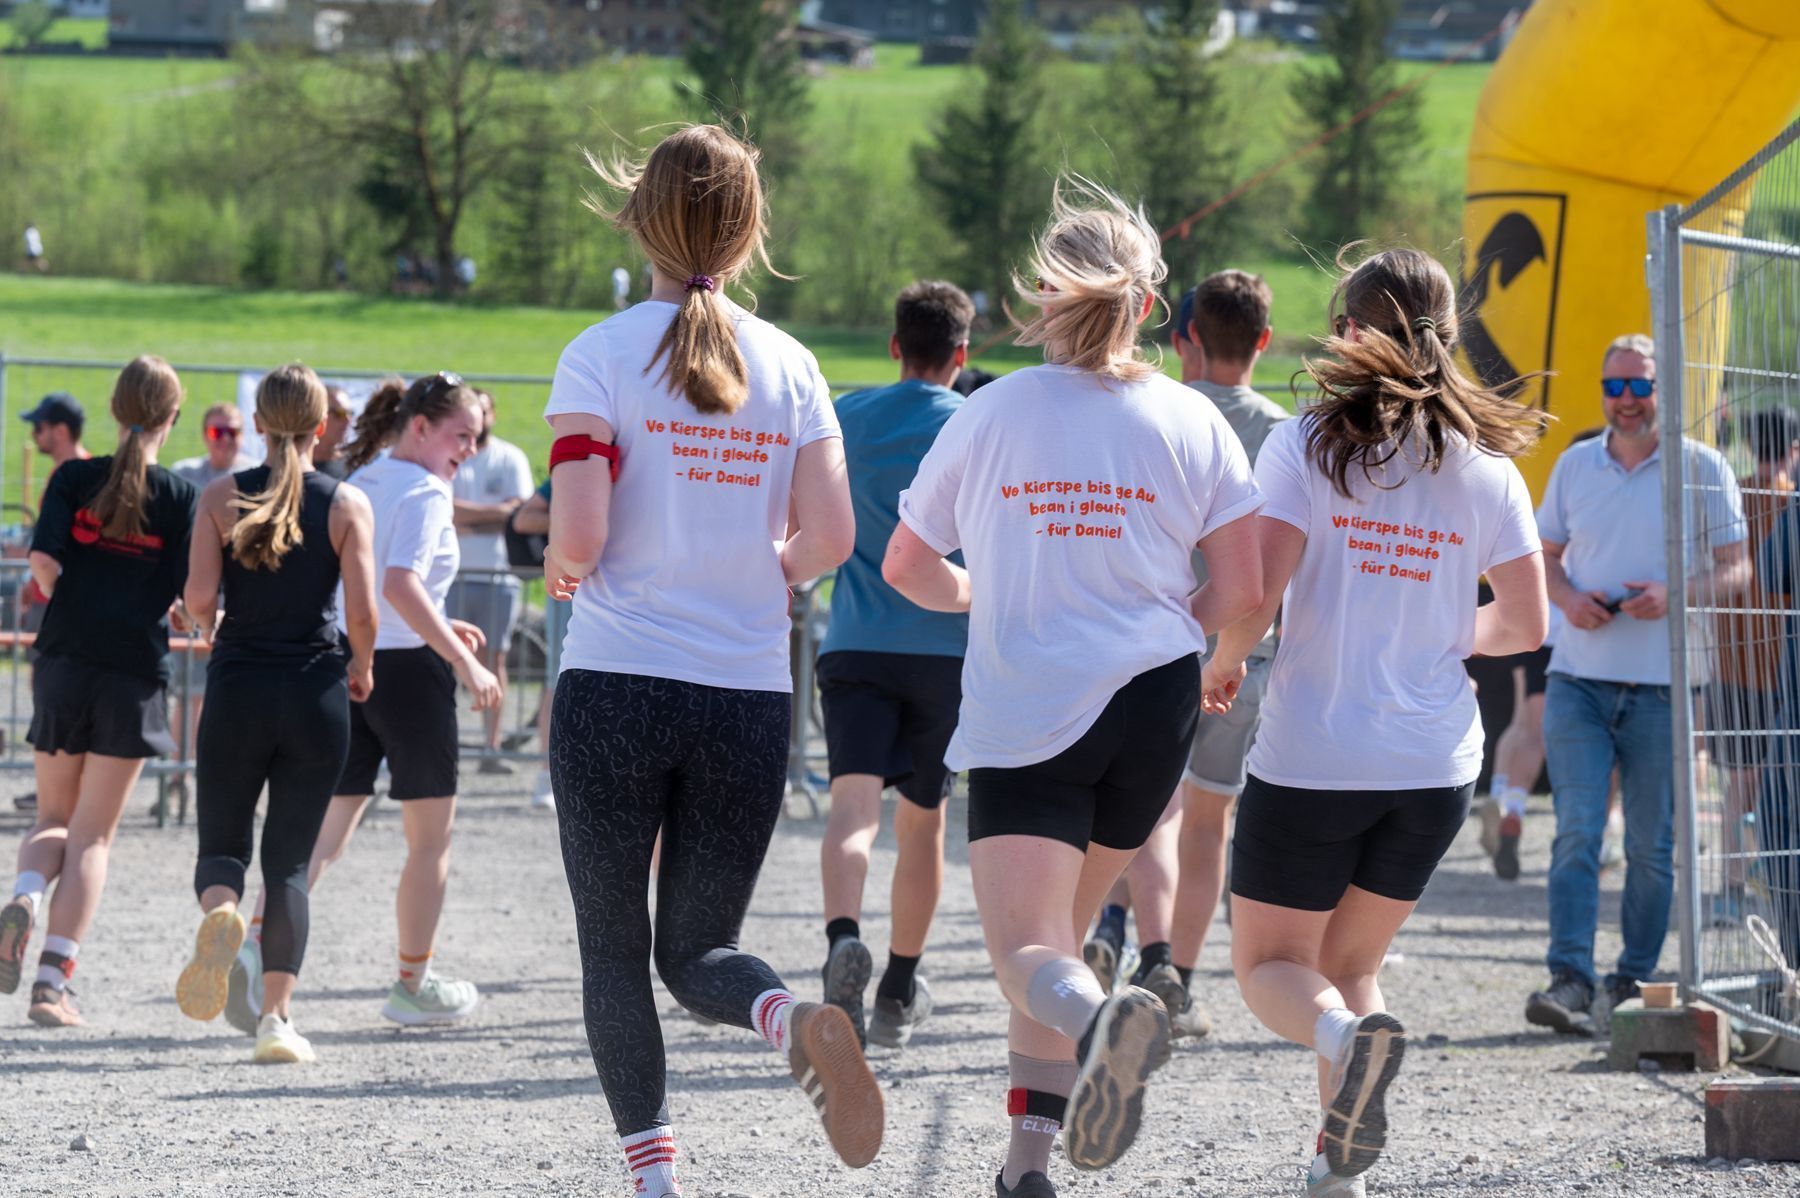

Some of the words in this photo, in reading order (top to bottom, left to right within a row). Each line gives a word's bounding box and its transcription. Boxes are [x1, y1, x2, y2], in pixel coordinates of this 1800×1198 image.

[669, 420, 725, 441] Kierspe
[730, 426, 752, 442] bis
[774, 432, 790, 446] Au
[672, 442, 709, 459] bean
[713, 447, 718, 460] i
[688, 467, 712, 483] für
[716, 470, 760, 487] Daniel
[1024, 480, 1082, 494] Kierspe
[1087, 480, 1111, 495] bis
[1135, 487, 1155, 503] Au
[1029, 501, 1065, 516] bean
[1070, 501, 1075, 513] i
[1047, 522, 1071, 537] für
[1075, 523, 1122, 539] Daniel
[1350, 516, 1400, 536] Kierspe
[1404, 523, 1424, 539] bis
[1448, 532, 1464, 545] Au
[1348, 535, 1382, 553] bean
[1386, 542, 1391, 554] i
[1360, 560, 1385, 575] für
[1389, 564, 1431, 583] Daniel
